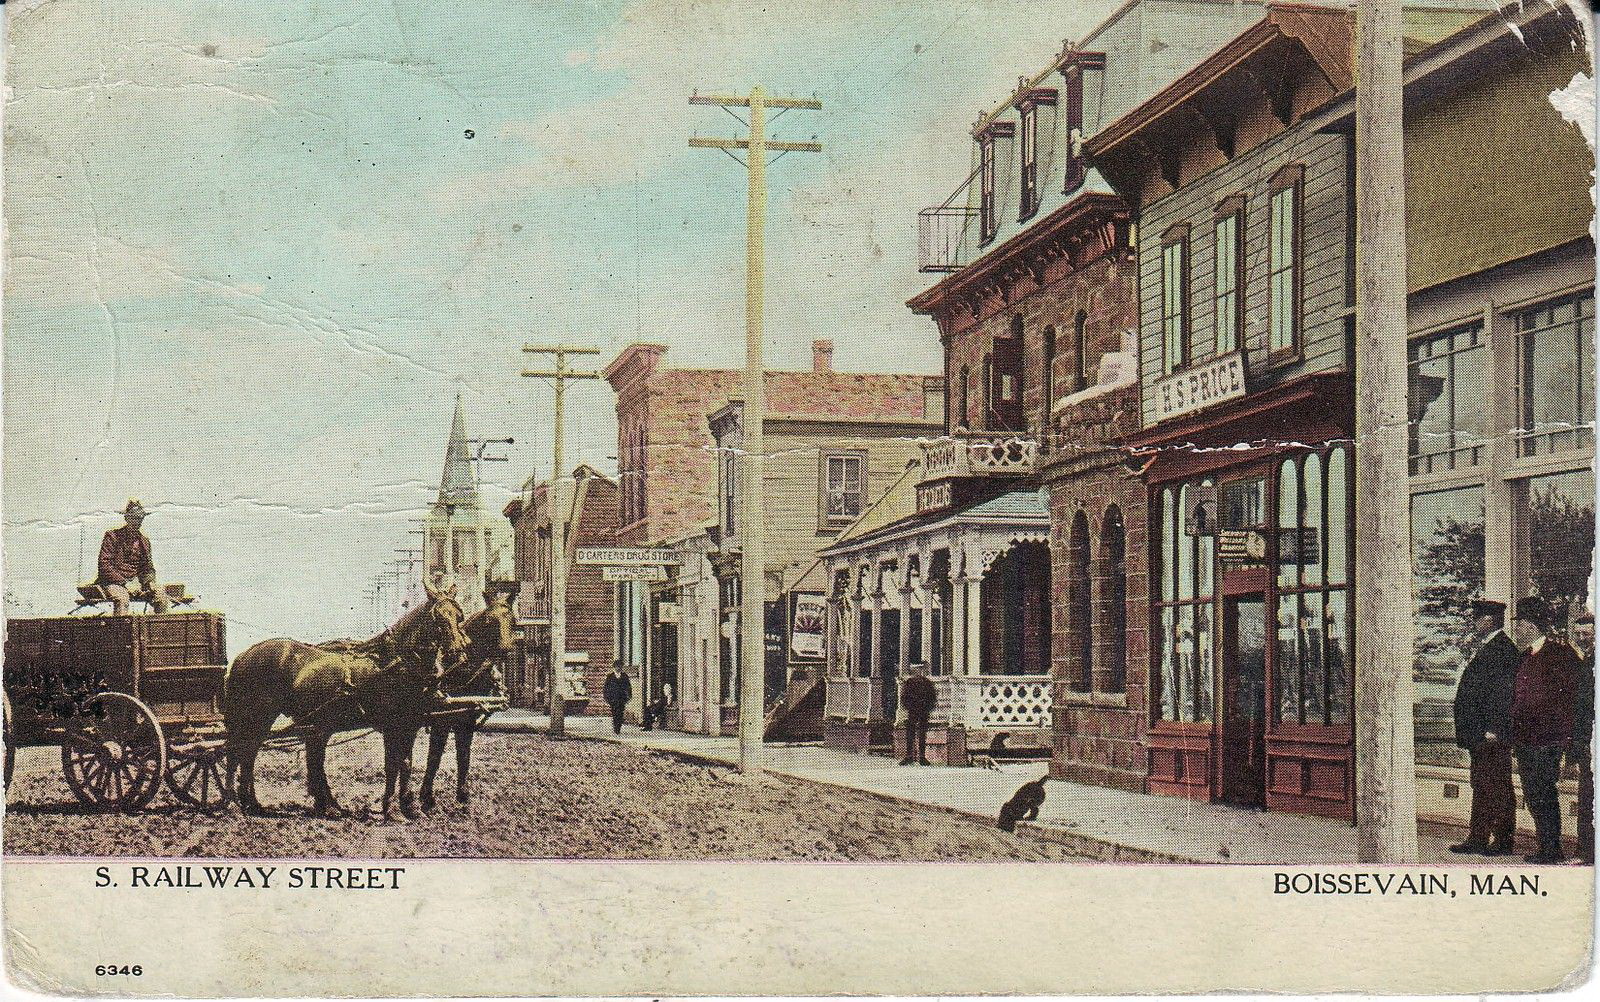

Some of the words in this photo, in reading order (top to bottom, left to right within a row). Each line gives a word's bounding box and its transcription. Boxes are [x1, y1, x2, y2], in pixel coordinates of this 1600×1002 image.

[1162, 383, 1172, 413] H
[1177, 380, 1185, 409] S
[1189, 360, 1241, 404] PRICE
[626, 550, 650, 560] DRUG
[651, 551, 681, 561] STORE
